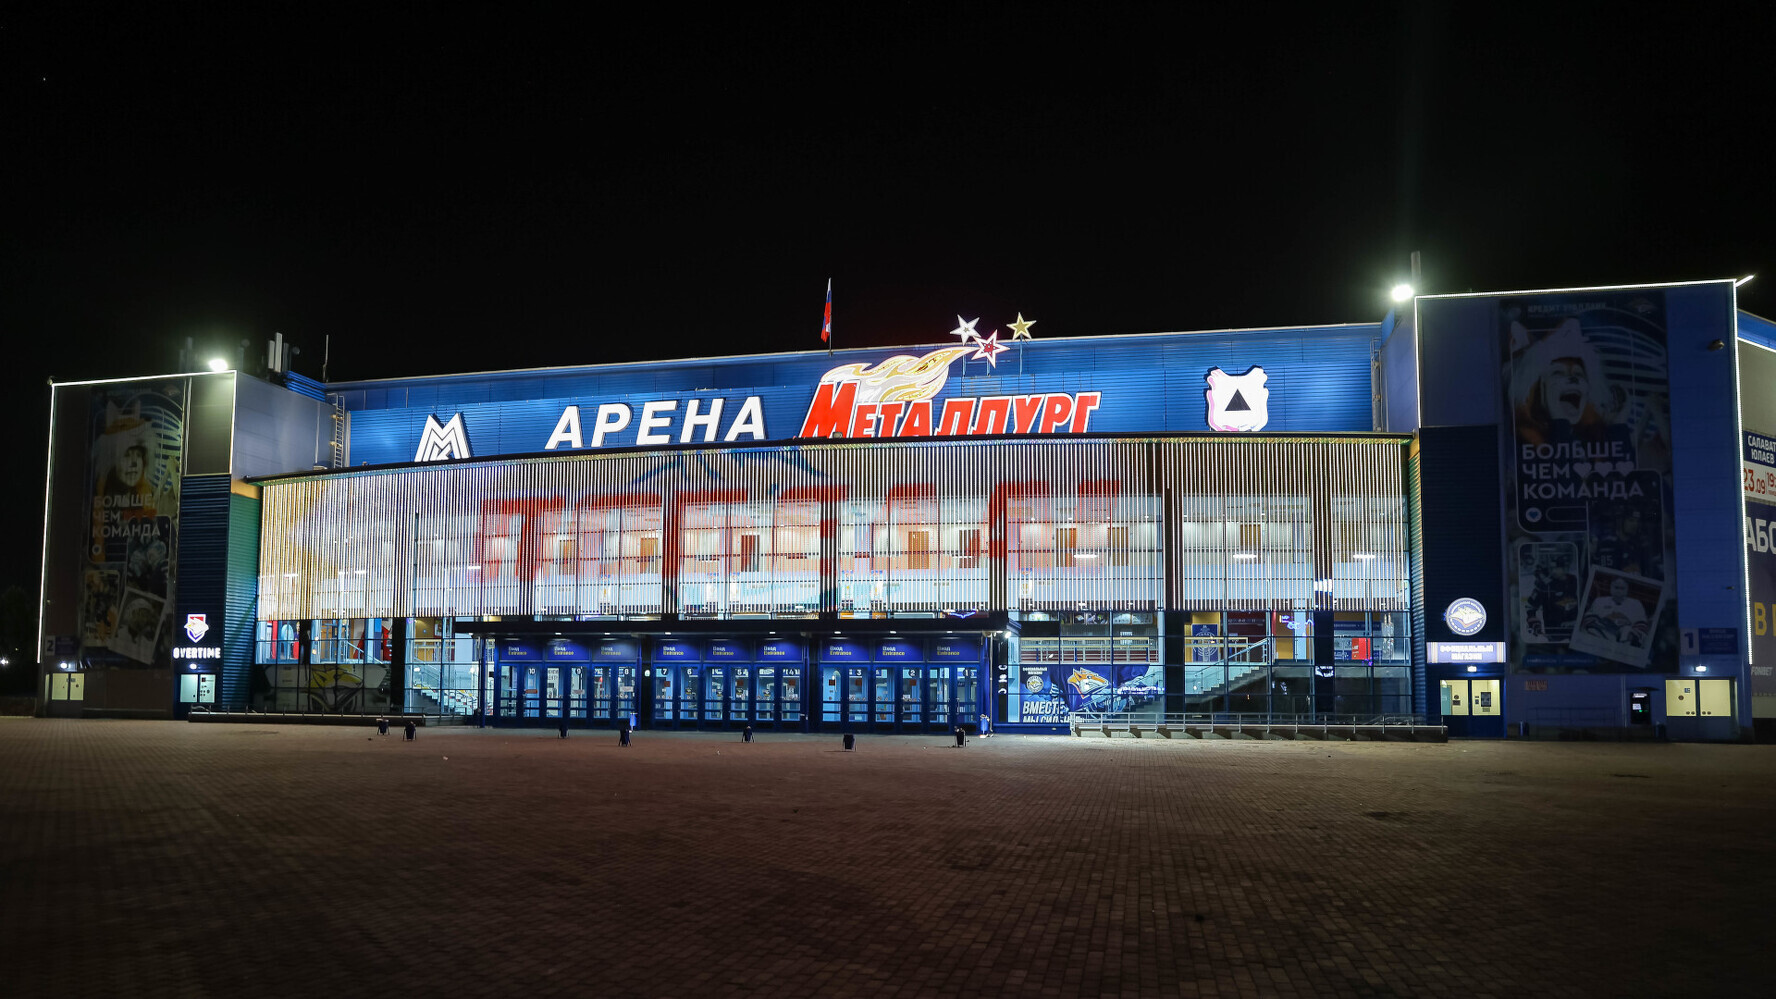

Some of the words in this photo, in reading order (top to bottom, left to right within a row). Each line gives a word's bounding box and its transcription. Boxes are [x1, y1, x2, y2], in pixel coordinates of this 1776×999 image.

[545, 396, 767, 450] АРЕНА
[1521, 440, 1631, 461] БОЛЬШЕ,
[1748, 435, 1776, 453] САЛАВАТ
[1751, 448, 1775, 464] ЮЛАЕВ
[1521, 462, 1571, 480] ЧЕМ
[1523, 480, 1645, 501] КОМАНДА
[92, 510, 121, 523] ЧЕМ
[92, 523, 161, 539] КОМАНДА
[47, 640, 54, 652] 2
[1684, 632, 1694, 648] 1
[172, 647, 221, 659] OVERTIME
